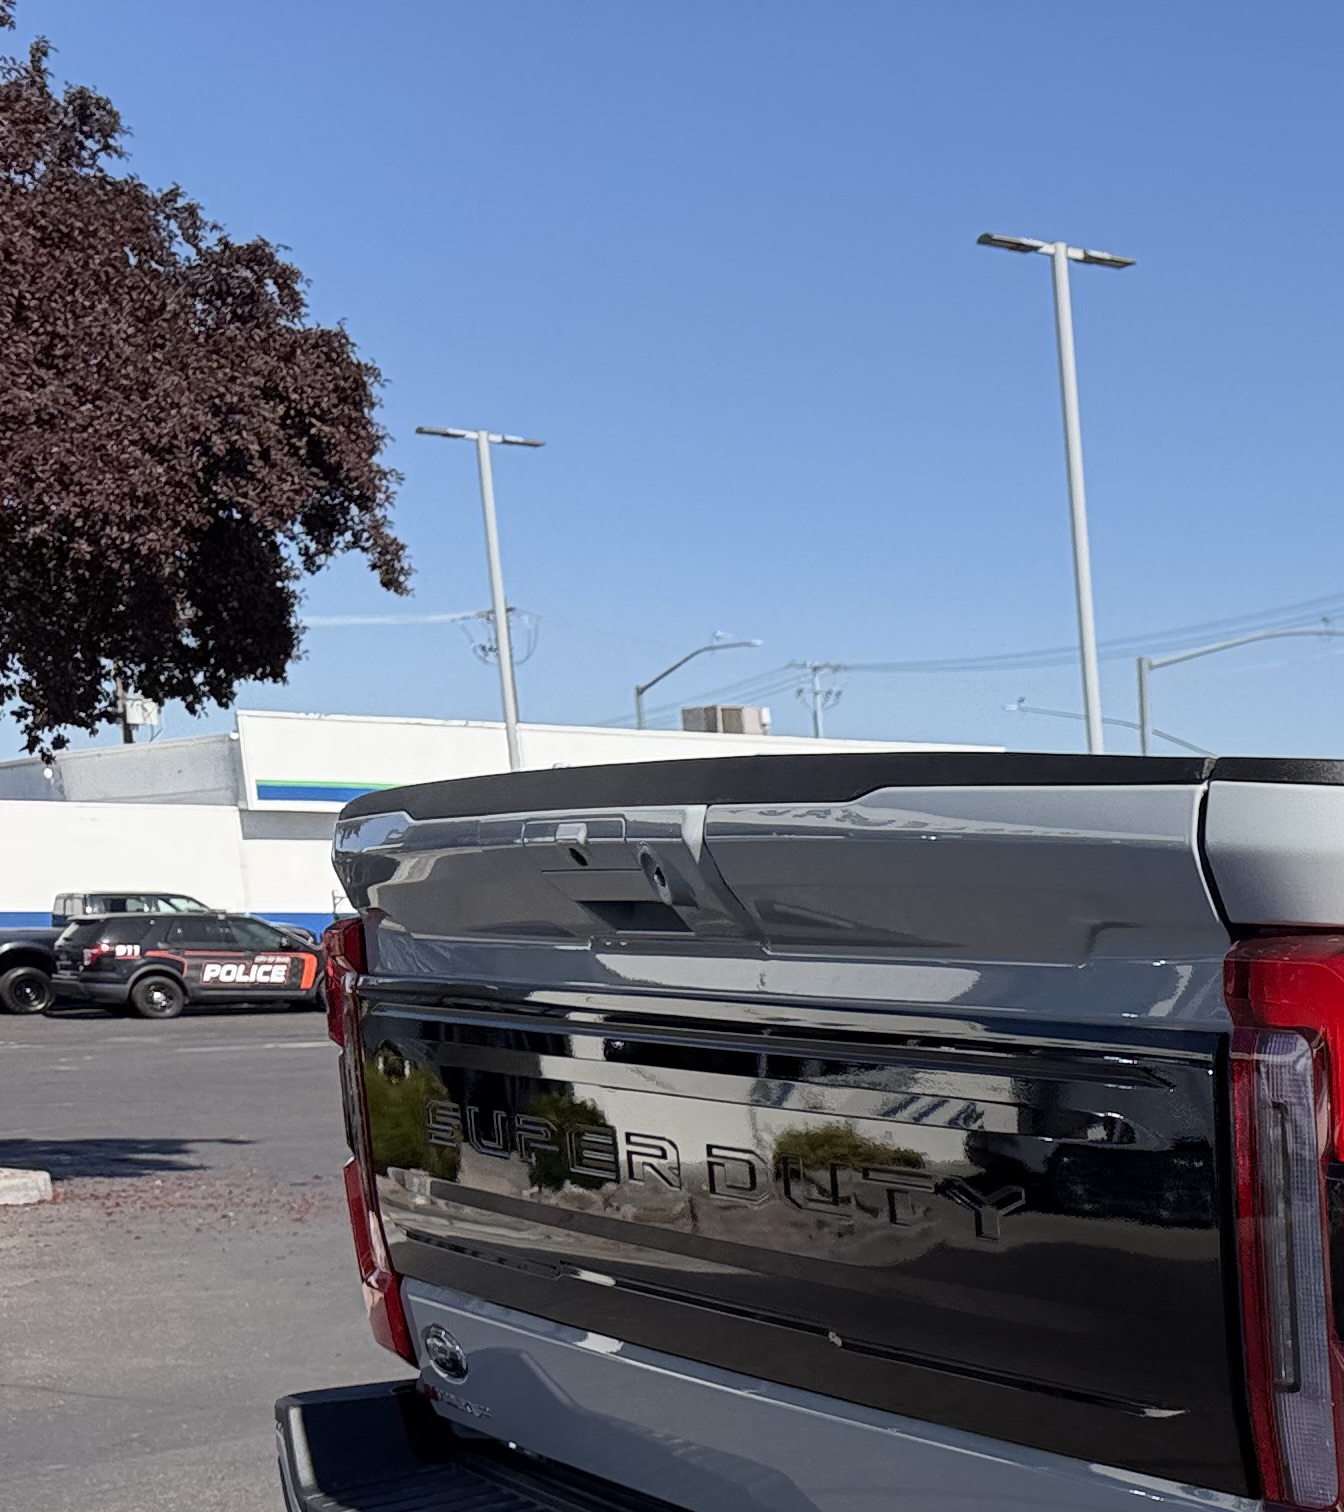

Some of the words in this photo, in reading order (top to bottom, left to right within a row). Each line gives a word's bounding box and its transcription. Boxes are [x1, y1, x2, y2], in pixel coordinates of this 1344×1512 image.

[203, 963, 288, 983] POLICE
[427, 1100, 683, 1191] SUPER
[706, 1143, 1026, 1241] DUTY
